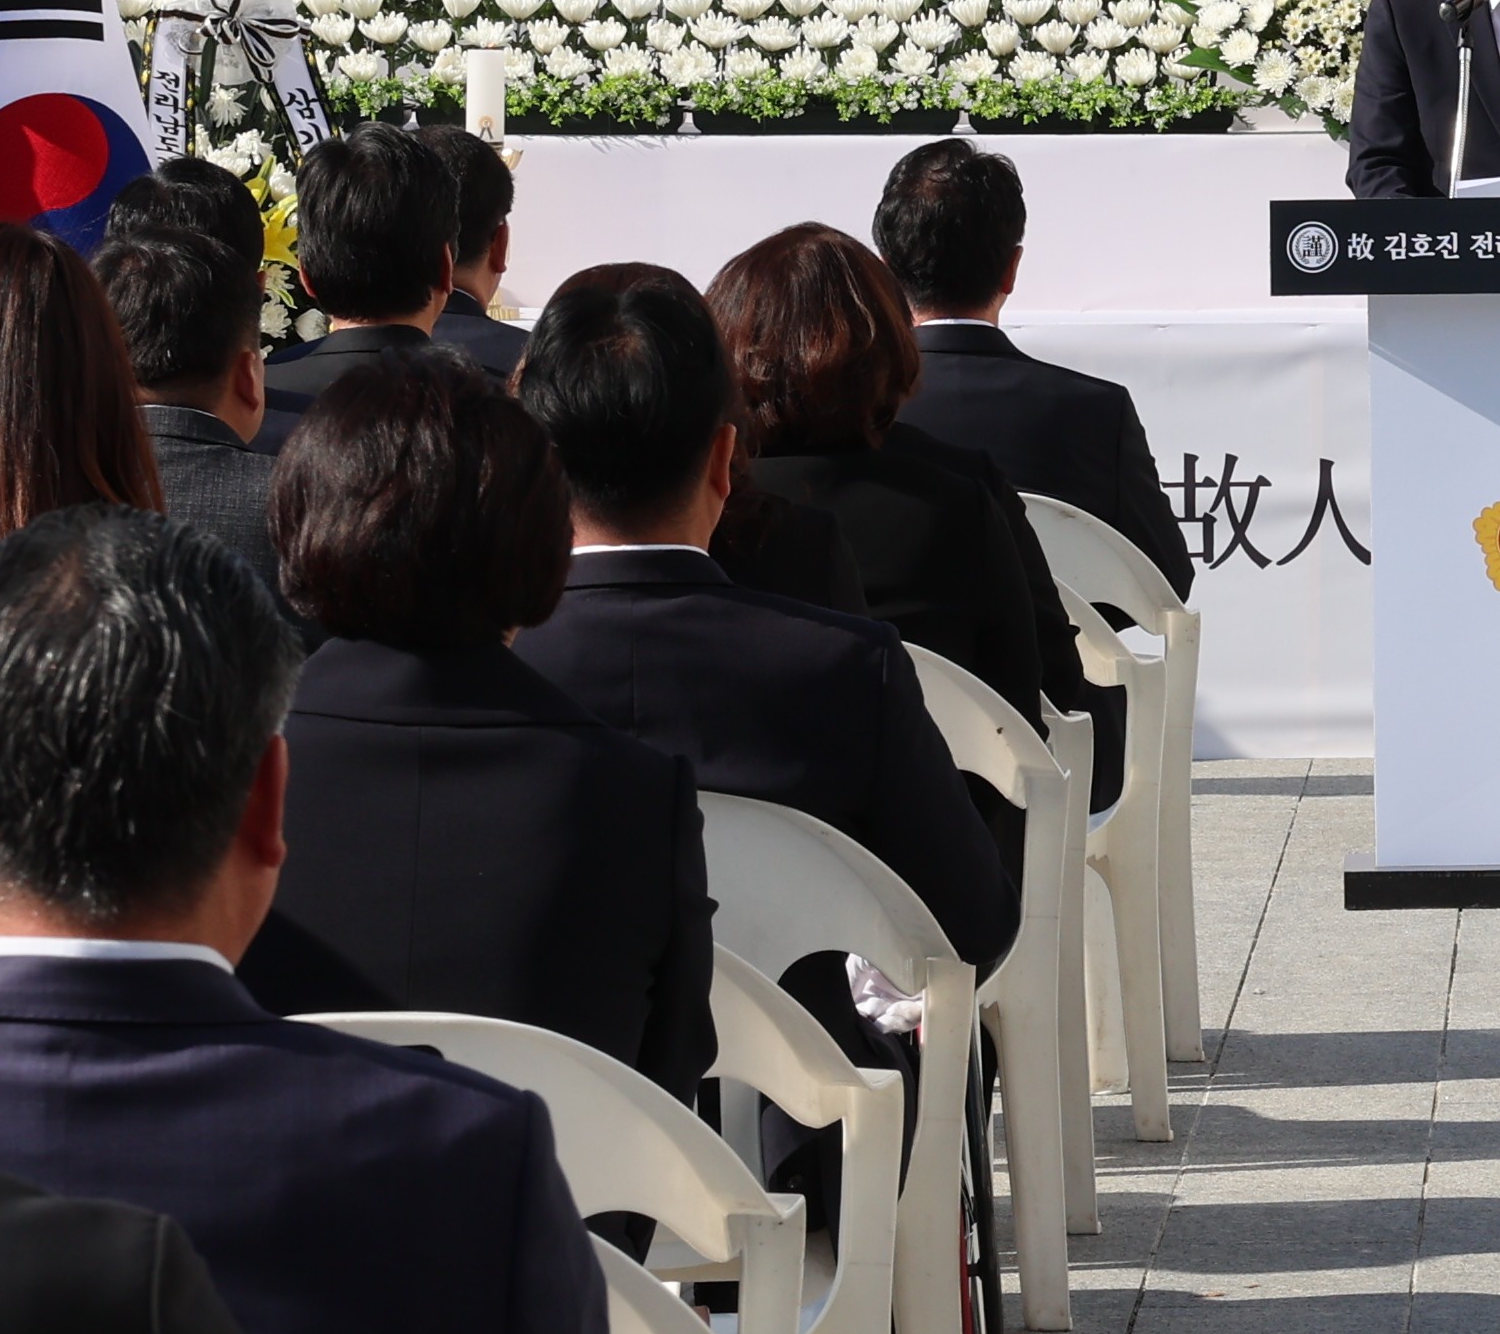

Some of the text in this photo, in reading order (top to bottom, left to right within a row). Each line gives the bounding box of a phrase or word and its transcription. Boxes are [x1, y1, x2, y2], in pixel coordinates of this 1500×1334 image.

[153, 70, 187, 161] 전라남도
[1347, 232, 1375, 261] 故
[1384, 231, 1460, 261] 김호진
